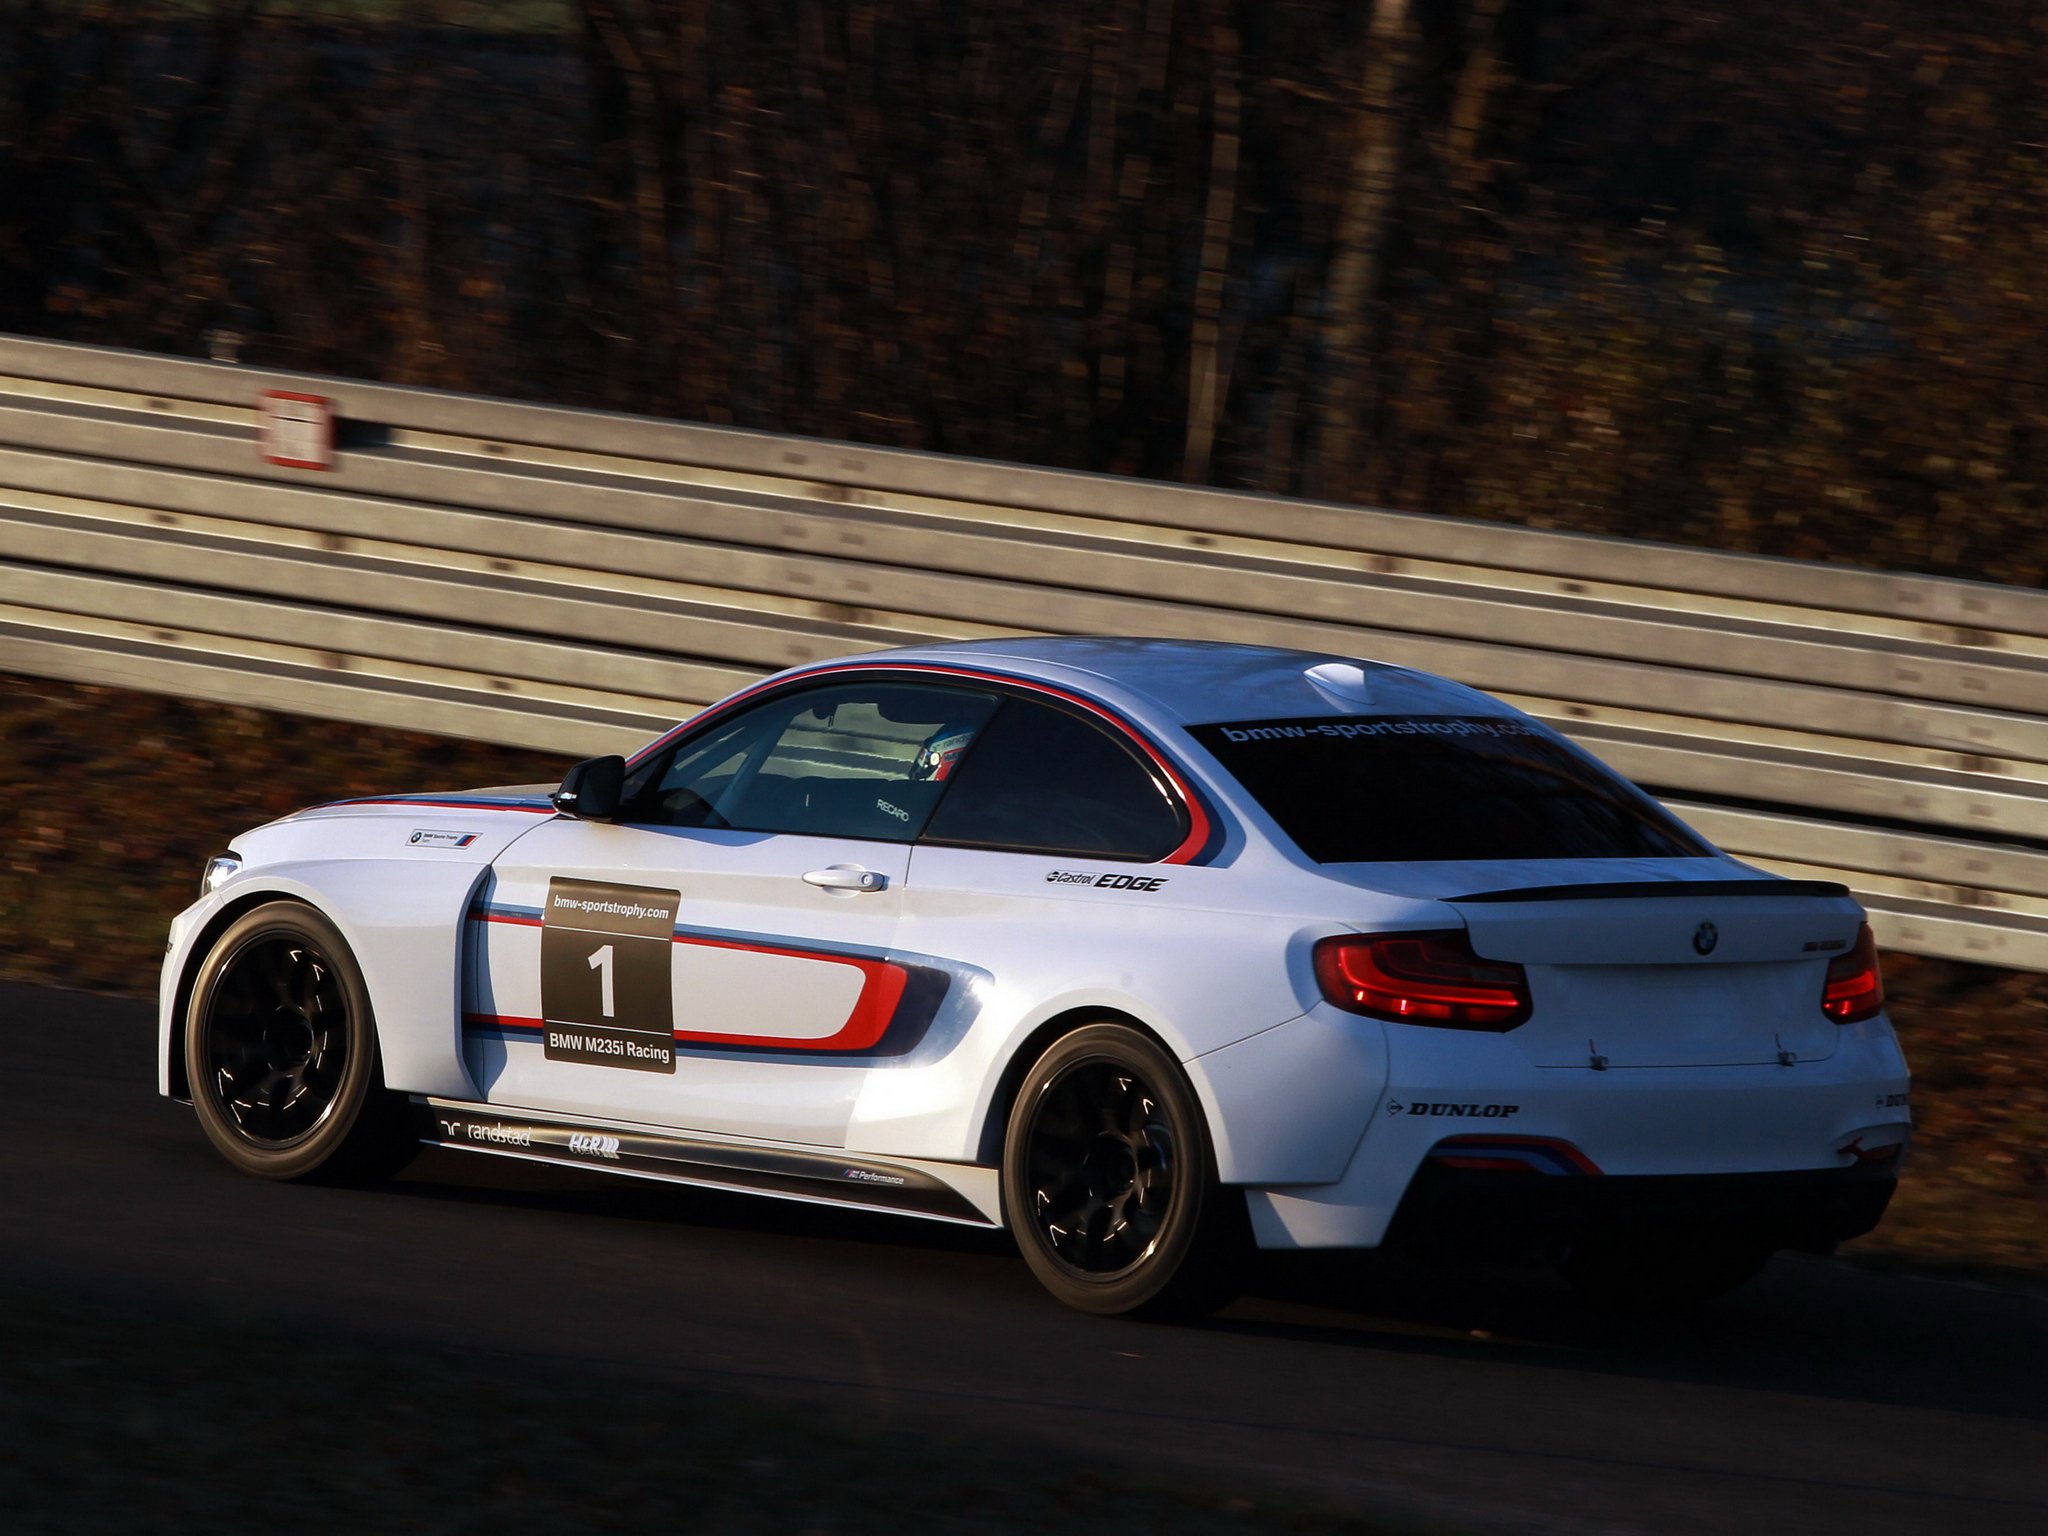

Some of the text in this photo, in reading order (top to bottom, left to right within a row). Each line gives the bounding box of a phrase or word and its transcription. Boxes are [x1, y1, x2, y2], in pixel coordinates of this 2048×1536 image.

[876, 798, 910, 822] RECARO
[1056, 872, 1170, 892] Castrol EDGE
[553, 894, 670, 920] bmw-sportstrophy.com
[587, 944, 615, 1018] 1
[549, 1032, 670, 1064] BMW M235i Racing
[1407, 1102, 1521, 1118] DUNLOP
[467, 1122, 532, 1147] randstad
[858, 1170, 905, 1185] Performance
